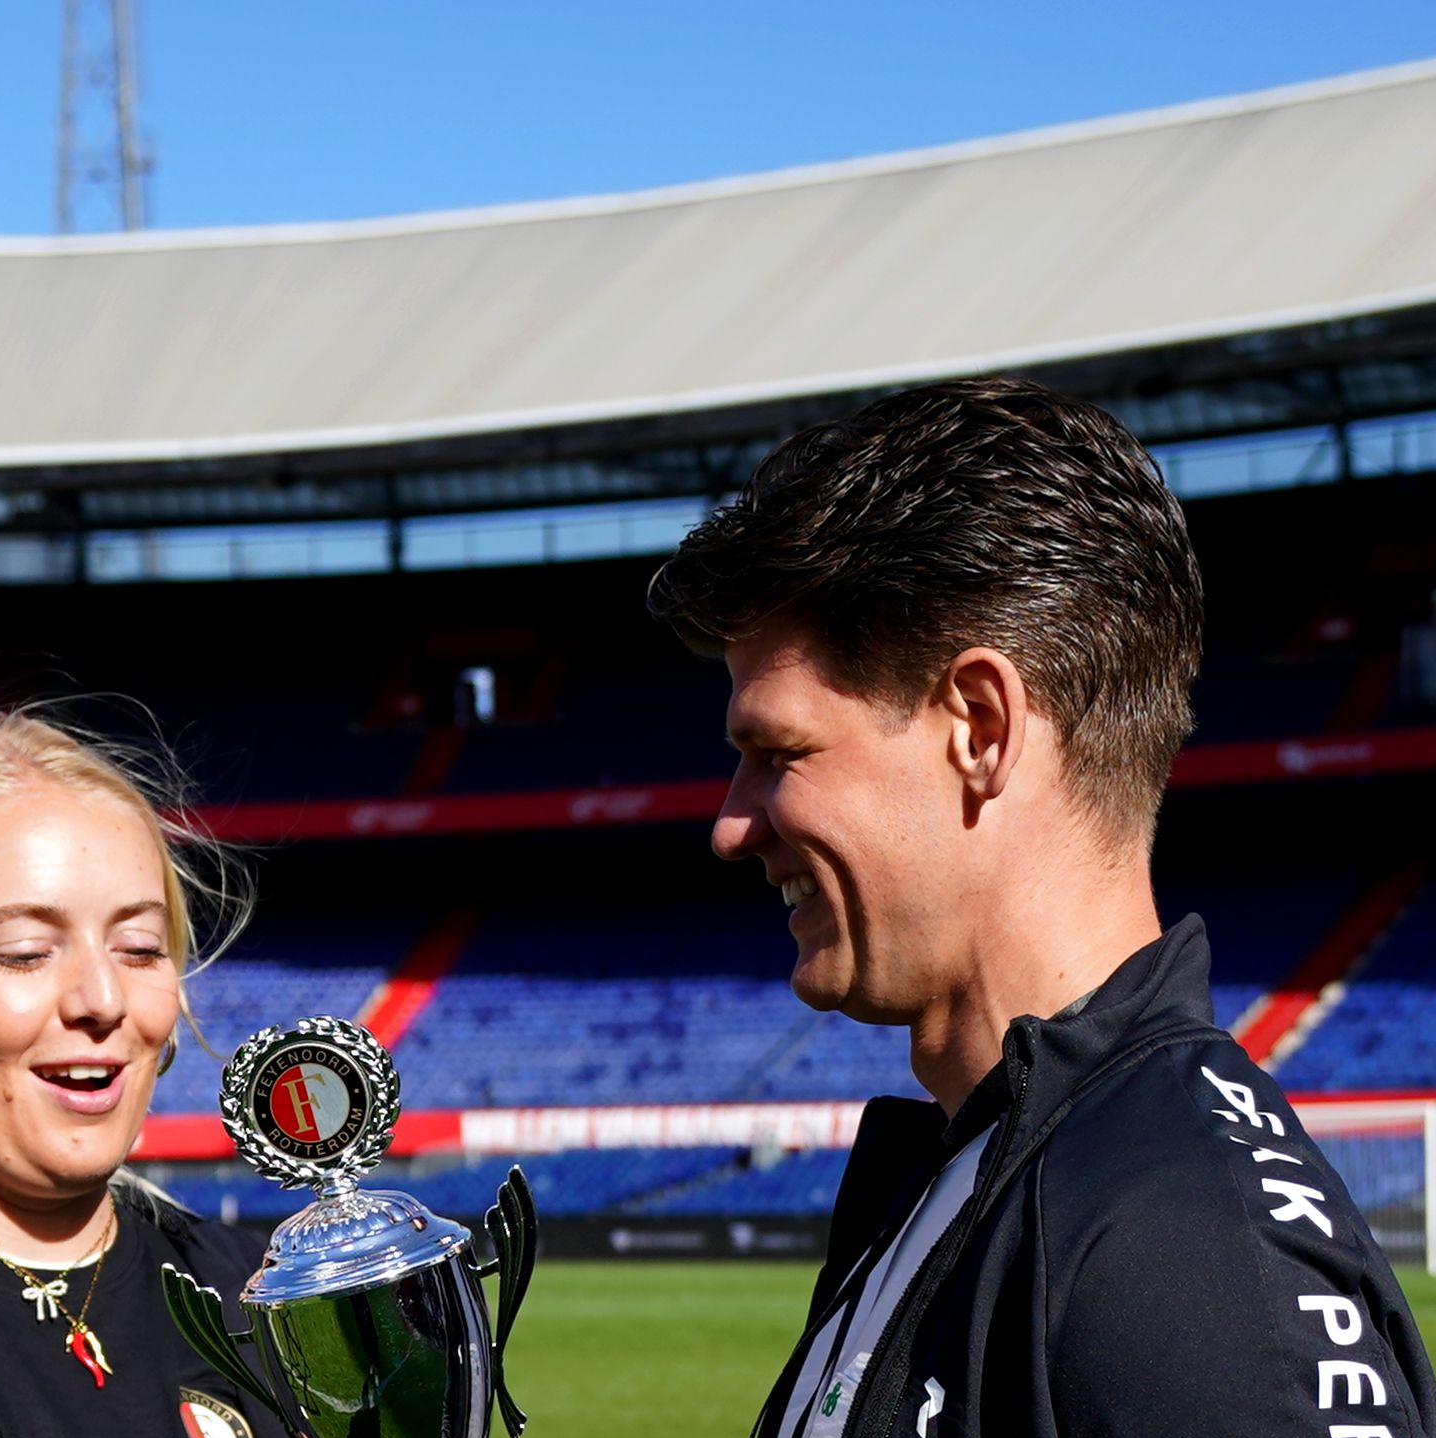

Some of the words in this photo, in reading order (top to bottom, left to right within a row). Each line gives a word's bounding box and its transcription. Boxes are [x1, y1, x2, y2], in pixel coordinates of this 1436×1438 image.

[256, 1048, 352, 1099] FEYENOORD
[282, 1072, 326, 1135] F
[268, 1107, 364, 1157] ROTTERDAM
